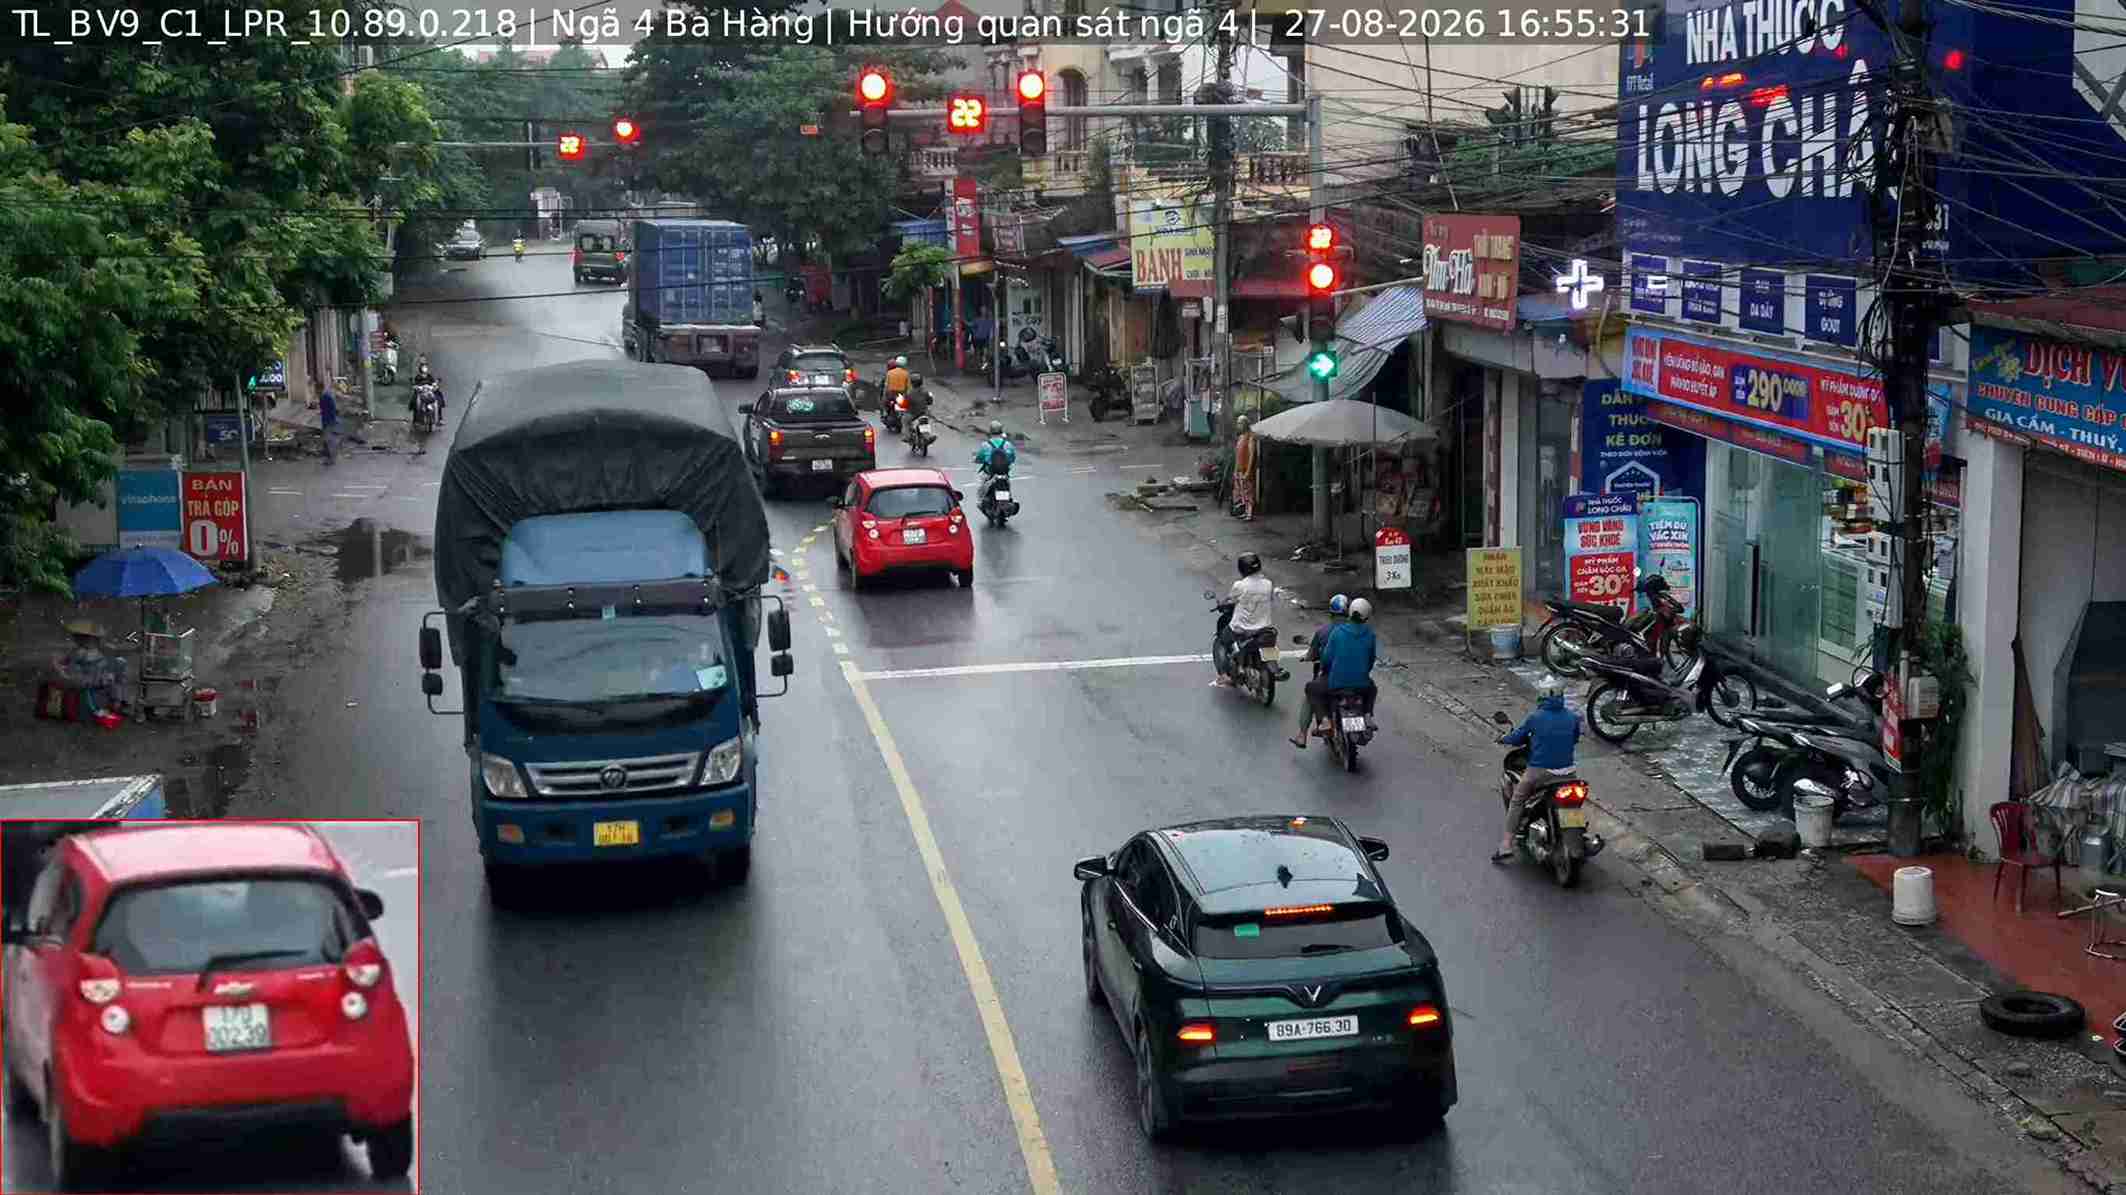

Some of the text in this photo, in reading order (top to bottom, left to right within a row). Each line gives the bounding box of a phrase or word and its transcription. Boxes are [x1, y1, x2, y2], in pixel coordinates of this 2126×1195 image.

[1635, 59, 1897, 199] LONG CHÂ
[1748, 369, 1783, 412] 290
[2101, 350, 2126, 393] V
[1984, 408, 2014, 425] GIA
